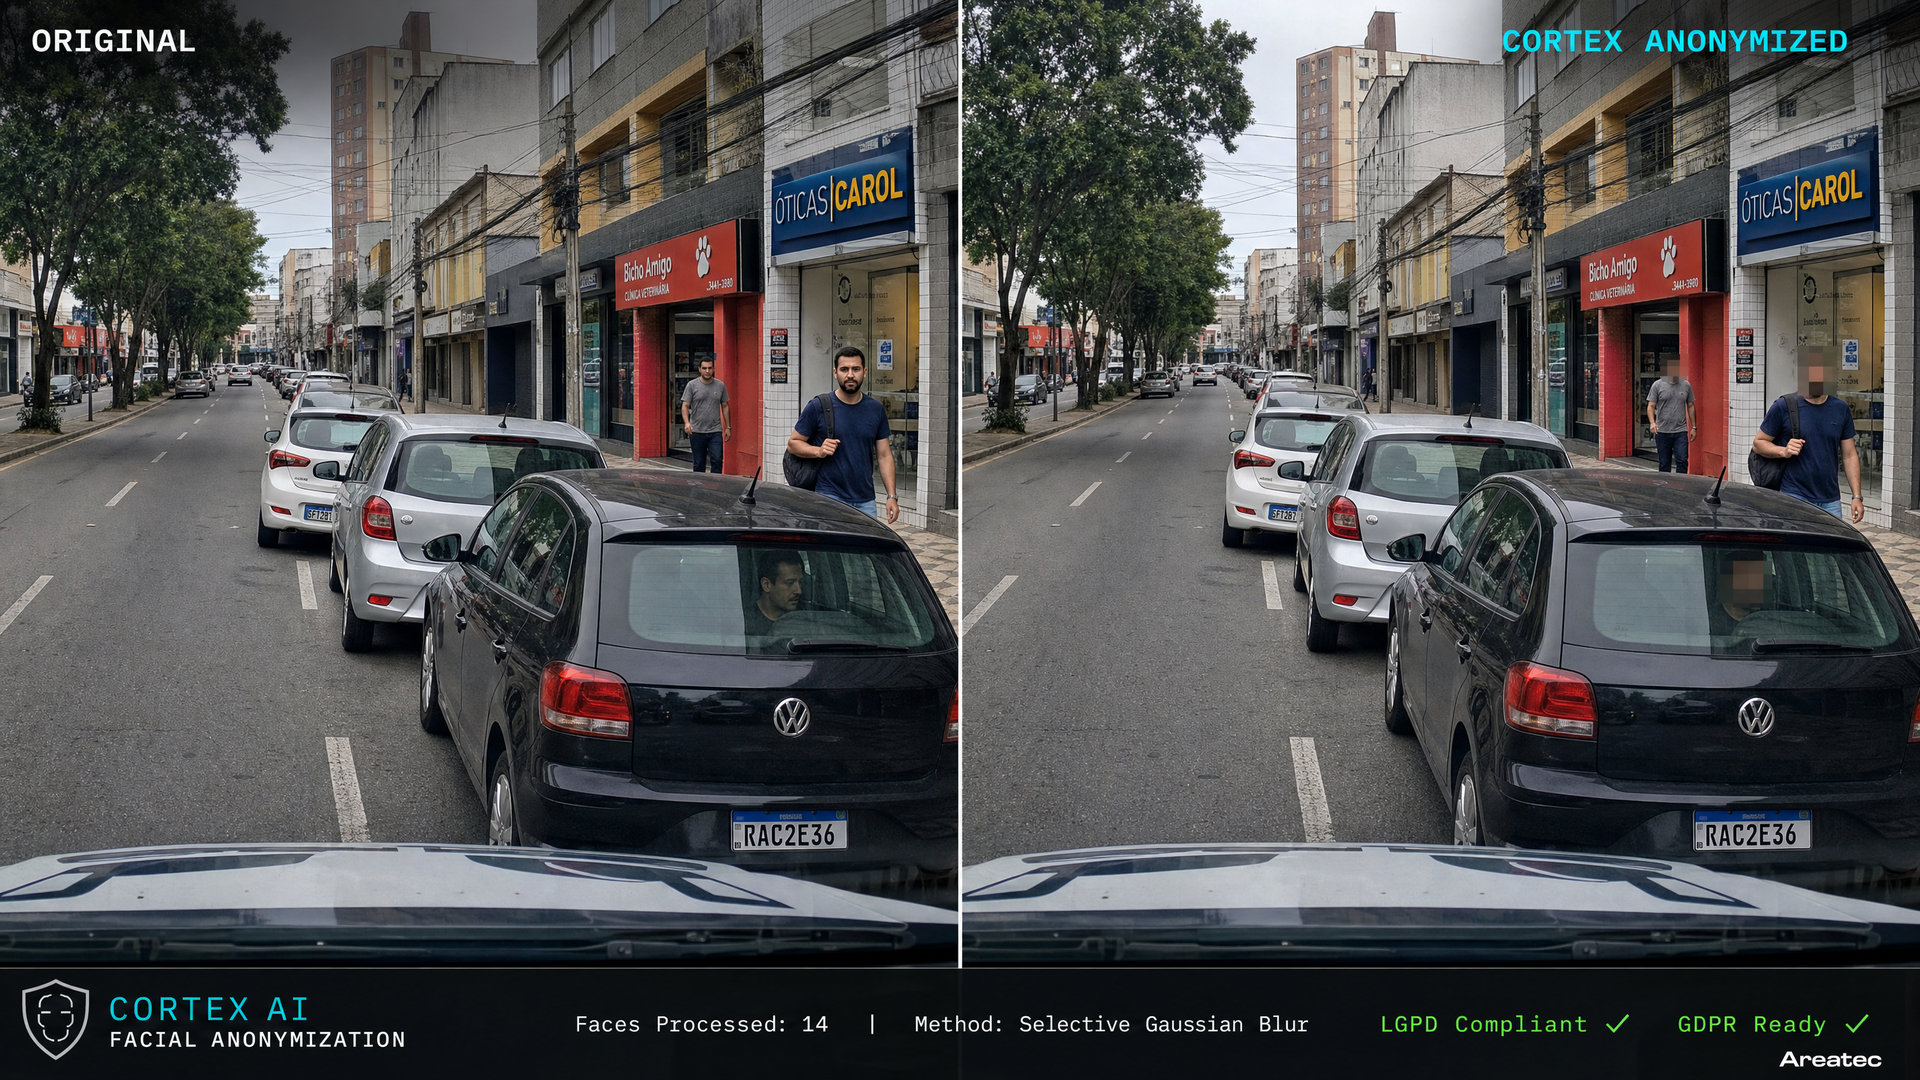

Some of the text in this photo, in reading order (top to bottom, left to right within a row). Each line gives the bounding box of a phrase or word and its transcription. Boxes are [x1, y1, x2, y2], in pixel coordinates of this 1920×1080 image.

[775, 167, 904, 225] ÓTICAS CAROL
[1741, 169, 1863, 224] ÓTICAS CAROL
[623, 260, 644, 283] Bicho
[645, 253, 672, 280] Amigo
[1588, 260, 1609, 283] Bicho
[1610, 253, 1638, 280] Amigo
[744, 824, 834, 847] RAC2E36
[1706, 824, 1797, 847] RAC2E36
